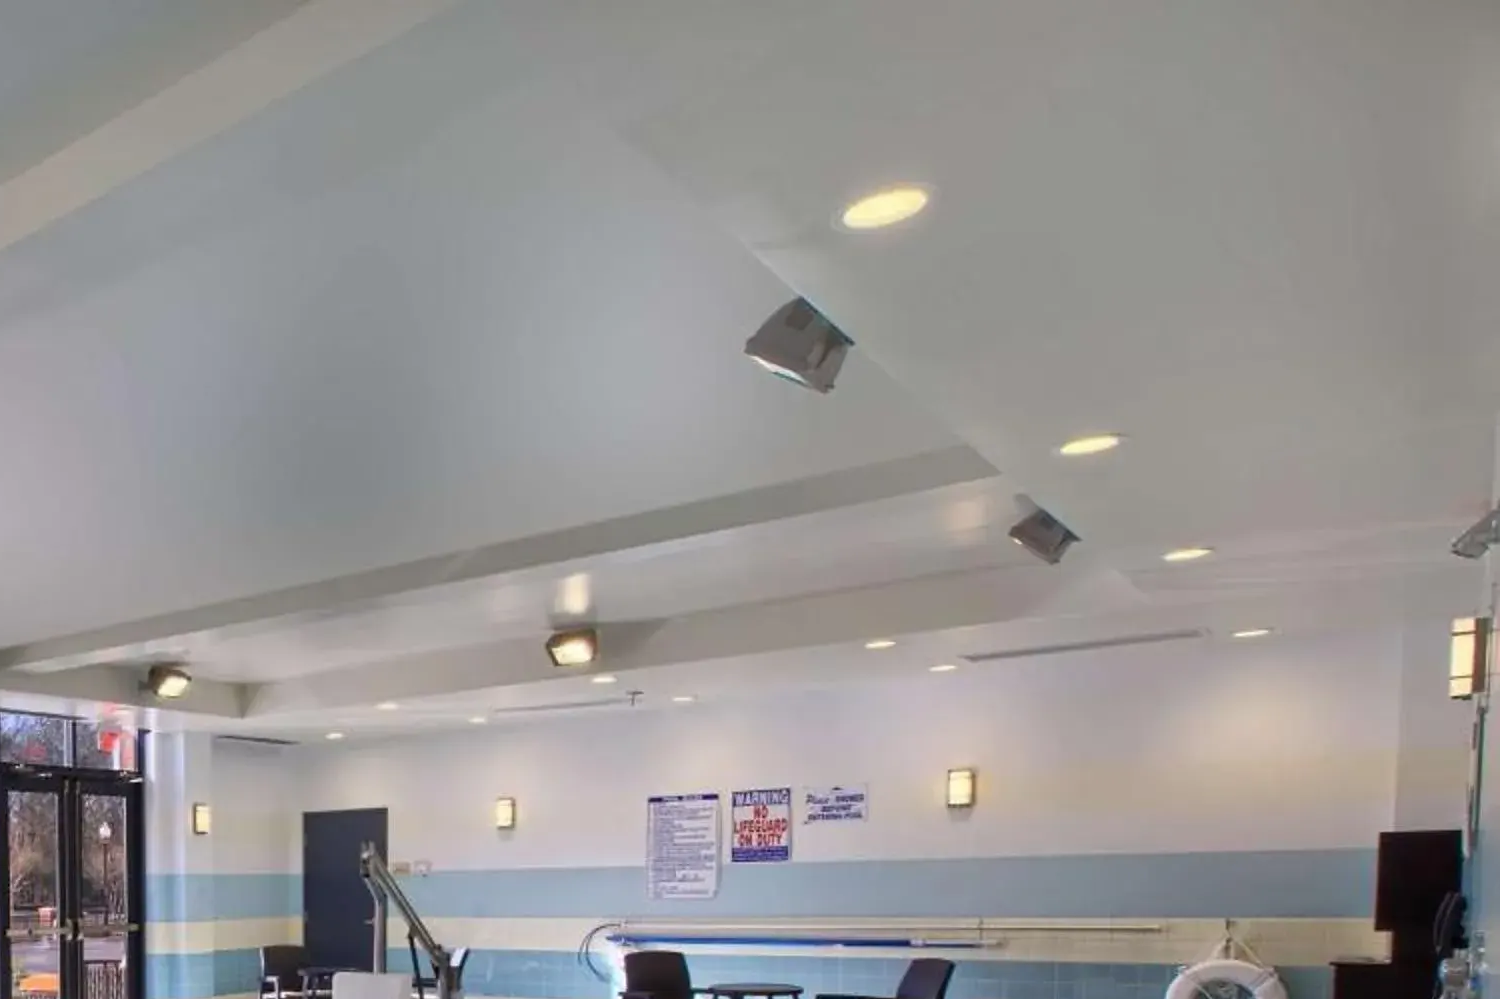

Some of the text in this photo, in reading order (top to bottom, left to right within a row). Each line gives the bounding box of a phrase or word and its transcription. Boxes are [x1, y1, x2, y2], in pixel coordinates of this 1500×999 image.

[735, 789, 788, 805] WARNING
[753, 804, 769, 819] NO
[733, 817, 788, 833] LIFEGUARD
[739, 832, 783, 847] ON DUTY
